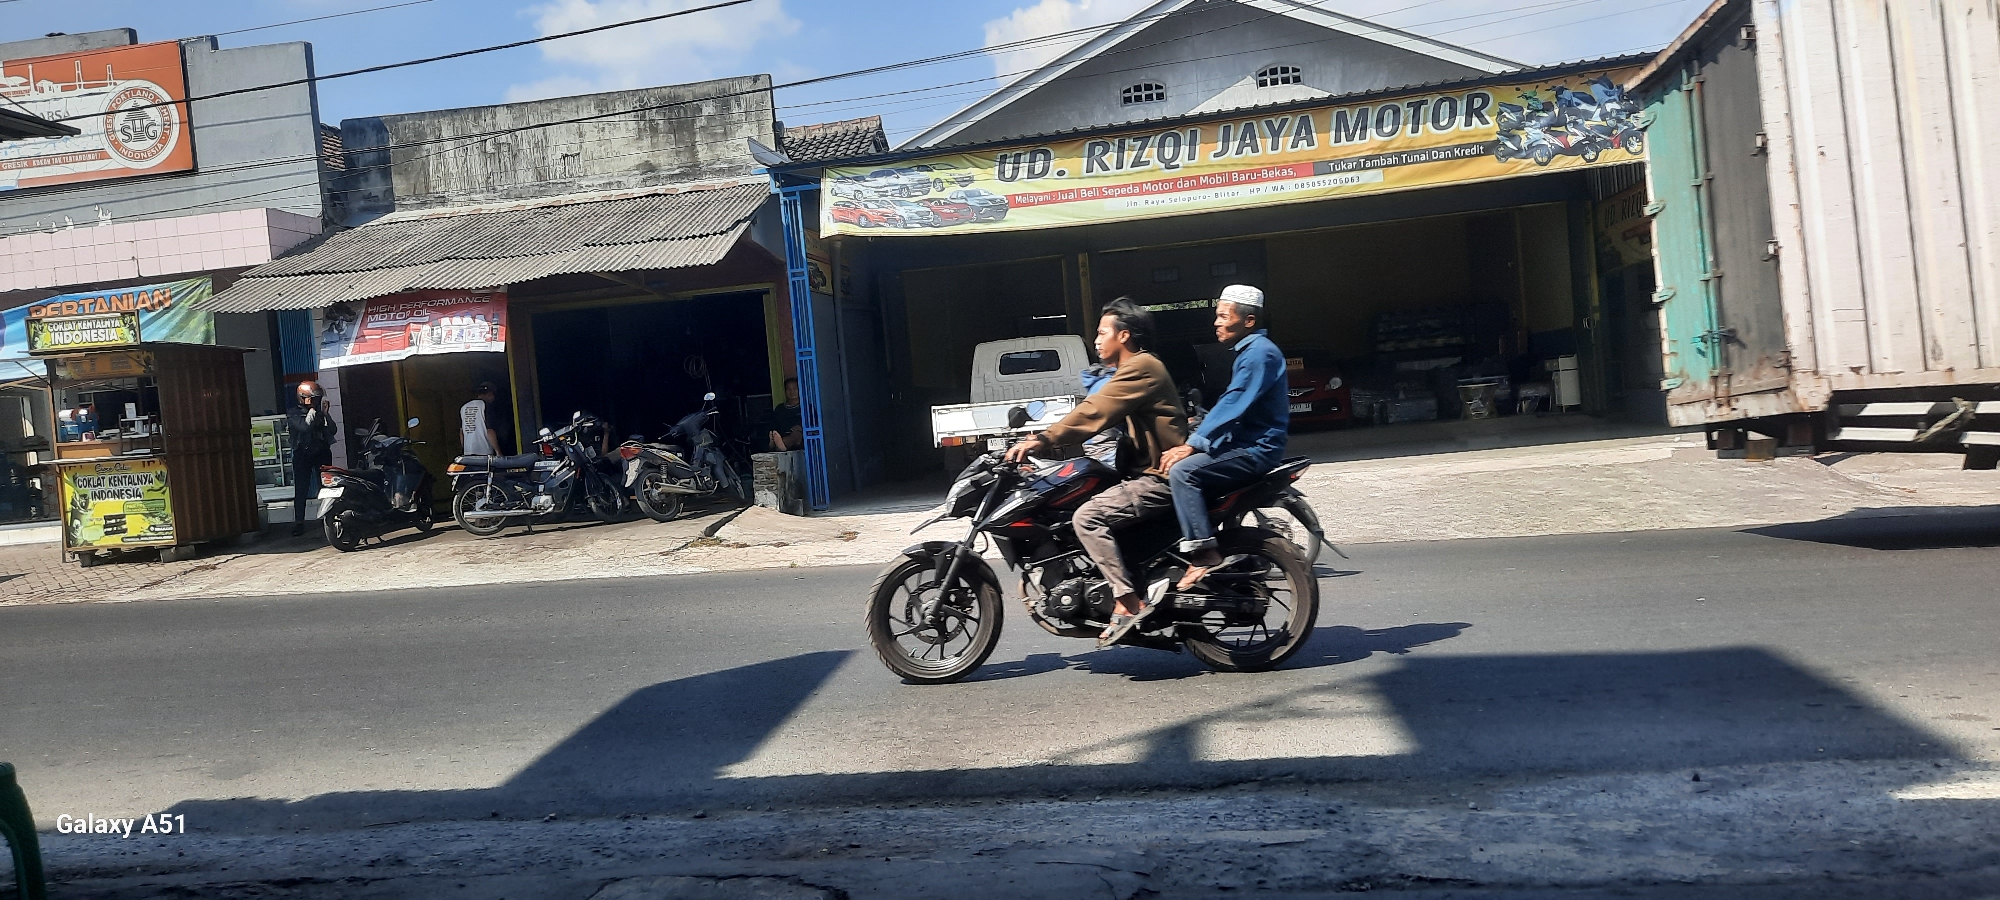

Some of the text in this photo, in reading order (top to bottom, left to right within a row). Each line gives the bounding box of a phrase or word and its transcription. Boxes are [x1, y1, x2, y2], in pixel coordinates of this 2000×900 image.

[111, 89, 155, 110] PORTLAND
[997, 91, 1491, 182] UD. RIZQI JAYA MOTOR
[118, 142, 165, 160] INDONESIA
[1328, 144, 1485, 173] Tukar Tambah Tunai Dan Kredit
[2, 160, 29, 170] GRESIK
[1056, 189, 1078, 201] Jual
[1080, 187, 1100, 198] Beli
[1102, 184, 1140, 198] Sepeda
[1142, 180, 1175, 193] Motor
[1177, 178, 1197, 189] dan
[1199, 174, 1229, 187] Mobil
[1231, 166, 1297, 183] Baru-Bekas,
[1144, 198, 1165, 206] Raya
[1249, 187, 1261, 195] HP
[1271, 184, 1285, 193] WA
[29, 286, 172, 318] PERTANIAN
[367, 295, 491, 314] HIGH PERFORMANCE
[367, 308, 432, 322] MOTOR OIL
[48, 318, 121, 333] COKLAT KENTALNYA
[50, 328, 119, 346] INDONESIA
[77, 472, 155, 489] COKLAT KENTALNYA
[90, 488, 143, 501] INDONESIA
